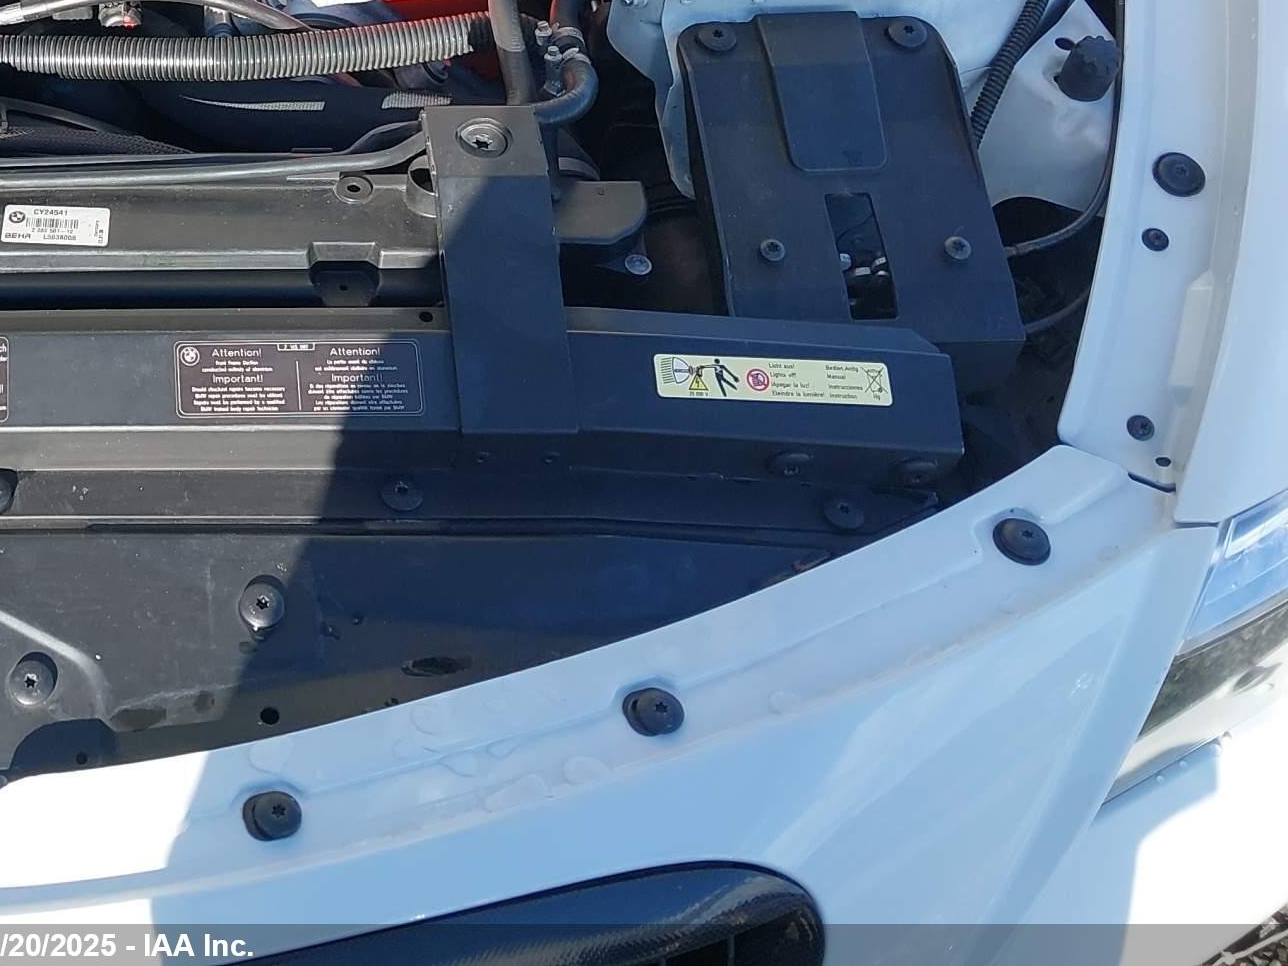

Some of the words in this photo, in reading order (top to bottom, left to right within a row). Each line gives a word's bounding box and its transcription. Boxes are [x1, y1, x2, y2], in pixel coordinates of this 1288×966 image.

[212, 348, 262, 357] Attention!
[329, 347, 381, 356] Attention!
[212, 374, 264, 384] Important!
[331, 373, 384, 383] Important!
